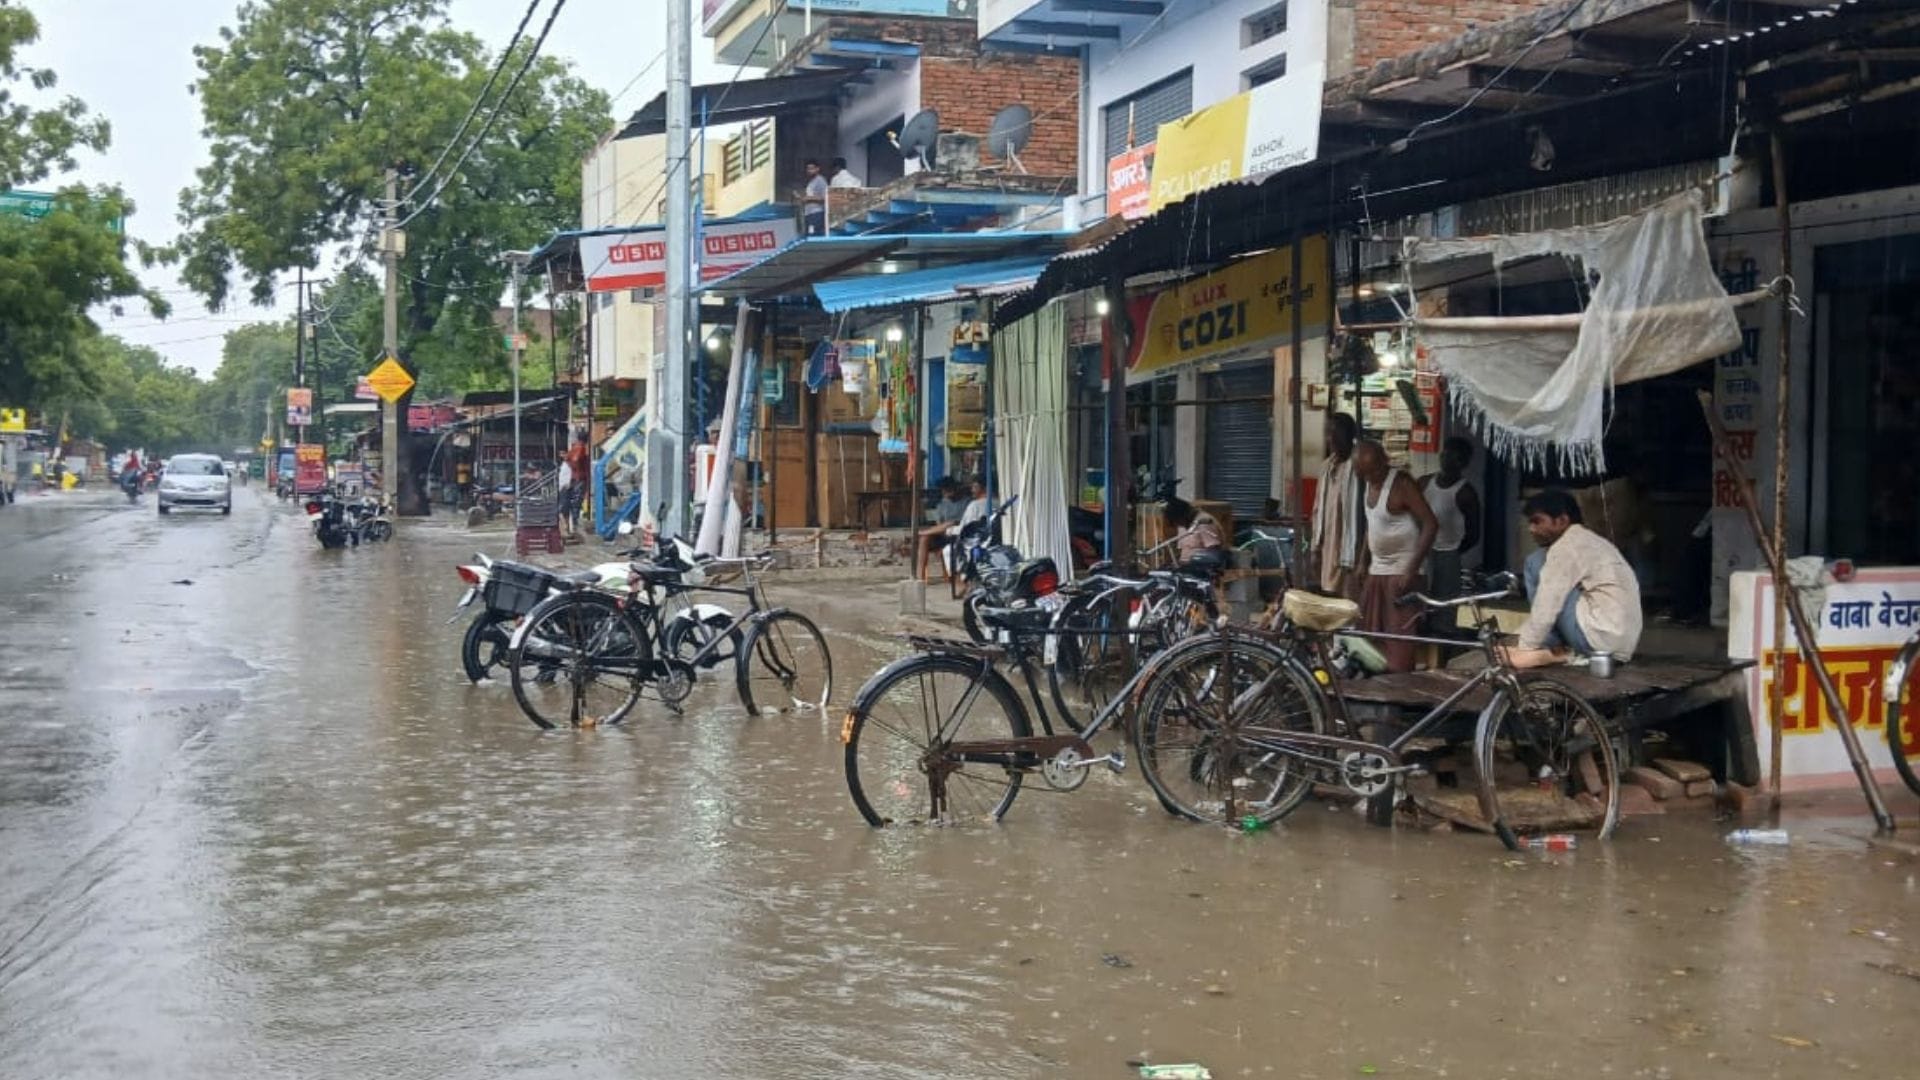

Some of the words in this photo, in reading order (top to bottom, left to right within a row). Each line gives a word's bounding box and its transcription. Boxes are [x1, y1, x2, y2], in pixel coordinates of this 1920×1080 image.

[1251, 136, 1284, 157] ASHOK
[610, 243, 664, 262] USH
[707, 232, 775, 253] USHA
[1192, 282, 1227, 308] LUX
[1178, 301, 1246, 351] COZI
